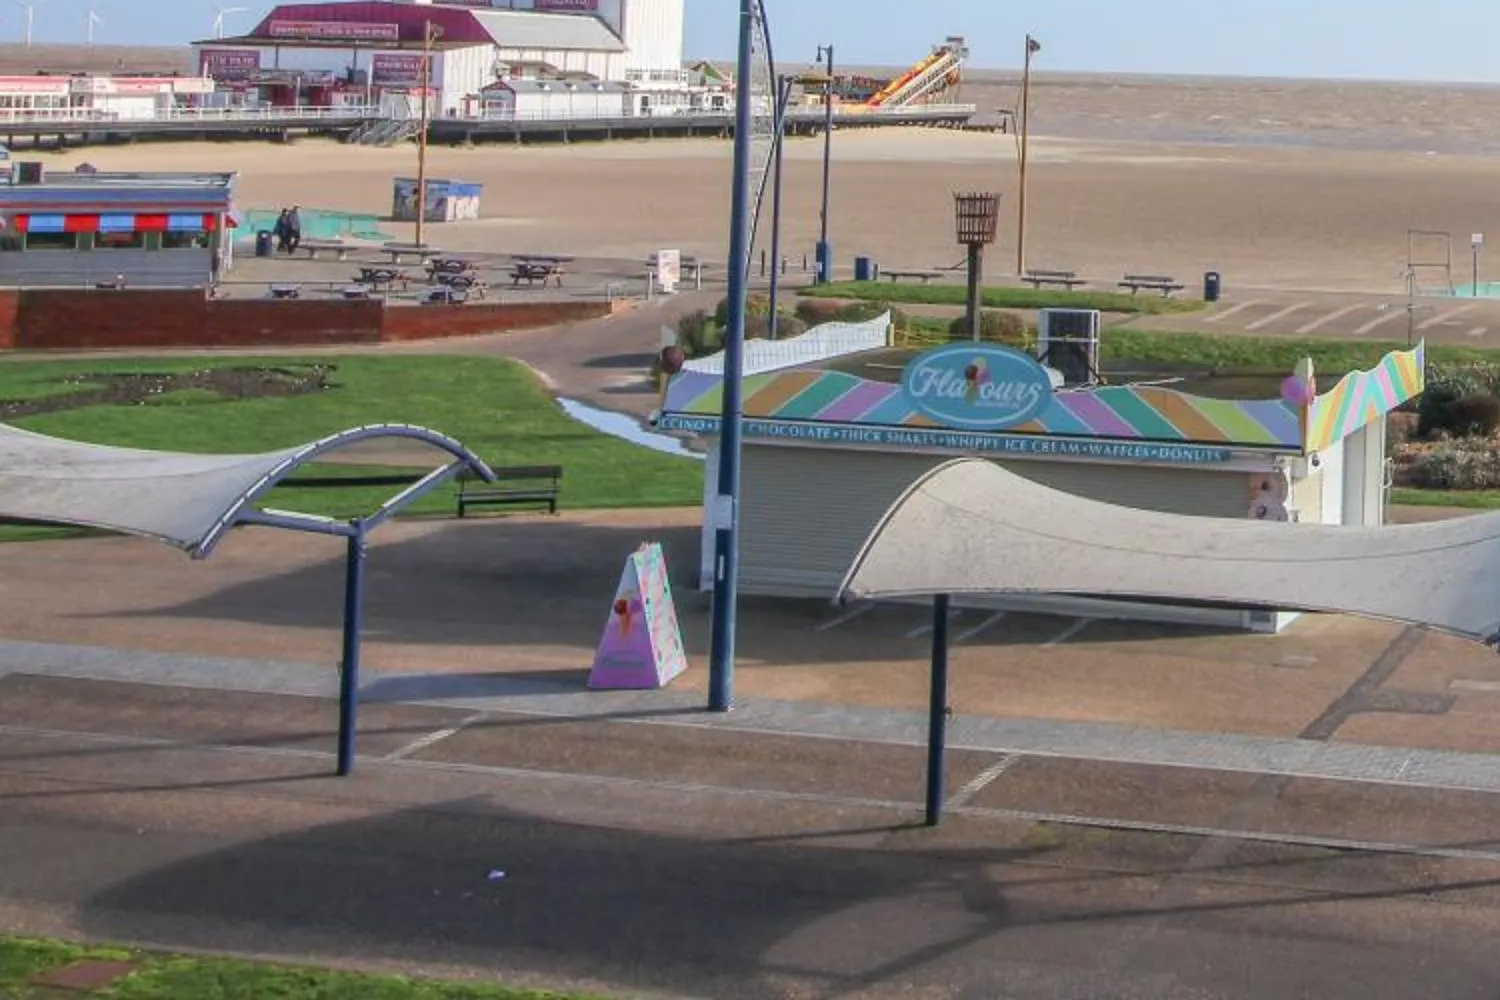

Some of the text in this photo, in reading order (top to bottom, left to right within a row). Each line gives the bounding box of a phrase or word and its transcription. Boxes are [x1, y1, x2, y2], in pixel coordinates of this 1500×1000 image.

[911, 367, 1043, 402] Flaours
[749, 423, 829, 440] CHOCOLATE
[841, 428, 881, 443] THICK
[886, 431, 938, 446] SHAKES
[945, 434, 998, 450] WHIPPY
[1005, 439, 1027, 451] ICE
[1031, 440, 1081, 454] CREAM
[1089, 443, 1151, 458] WAFFLES
[1159, 446, 1222, 461] DONUTS
